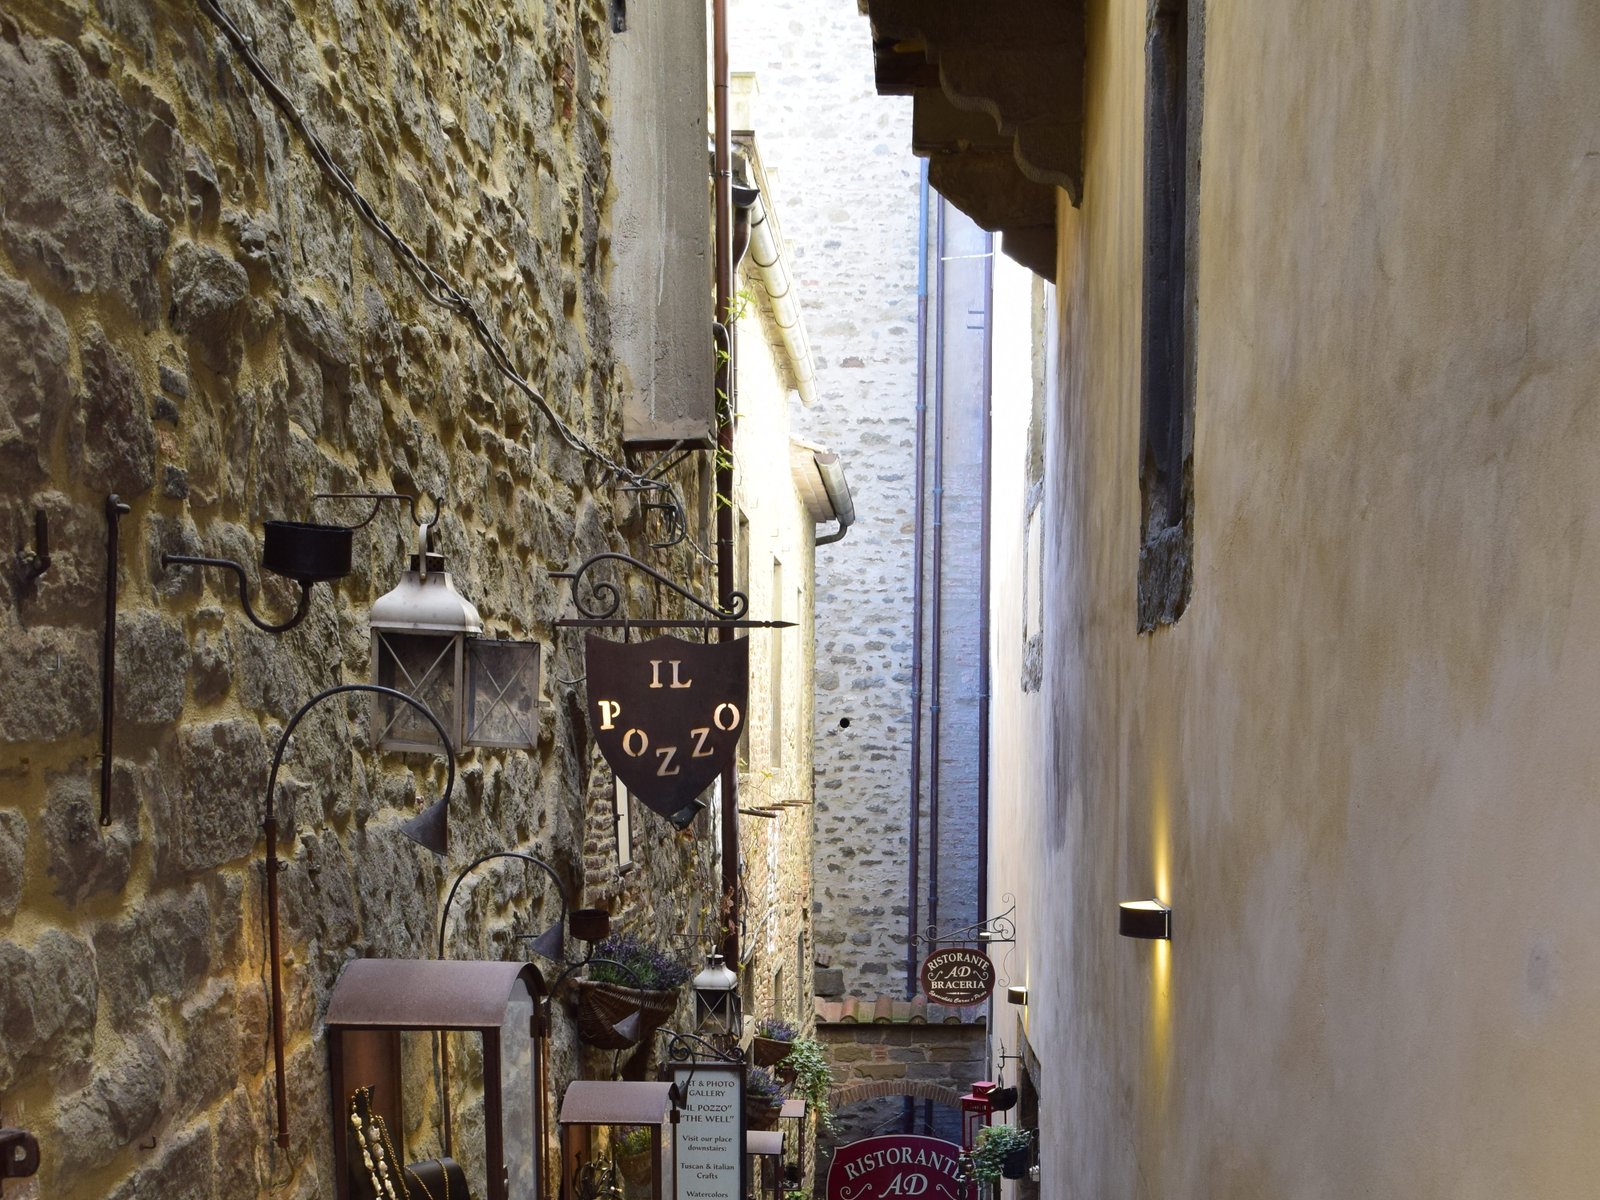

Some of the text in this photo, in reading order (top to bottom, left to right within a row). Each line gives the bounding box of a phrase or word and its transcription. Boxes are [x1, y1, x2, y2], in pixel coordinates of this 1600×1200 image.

[649, 660, 692, 689] IL
[597, 700, 740, 777] POZZO
[927, 952, 990, 971] RISTORANTE
[944, 966, 971, 979] AD
[931, 981, 985, 989] BRACERIA
[706, 1080, 735, 1088] PHOTO
[714, 1136, 732, 1144] place
[878, 1172, 928, 1199] AD
[686, 1190, 728, 1198] Watercolors
